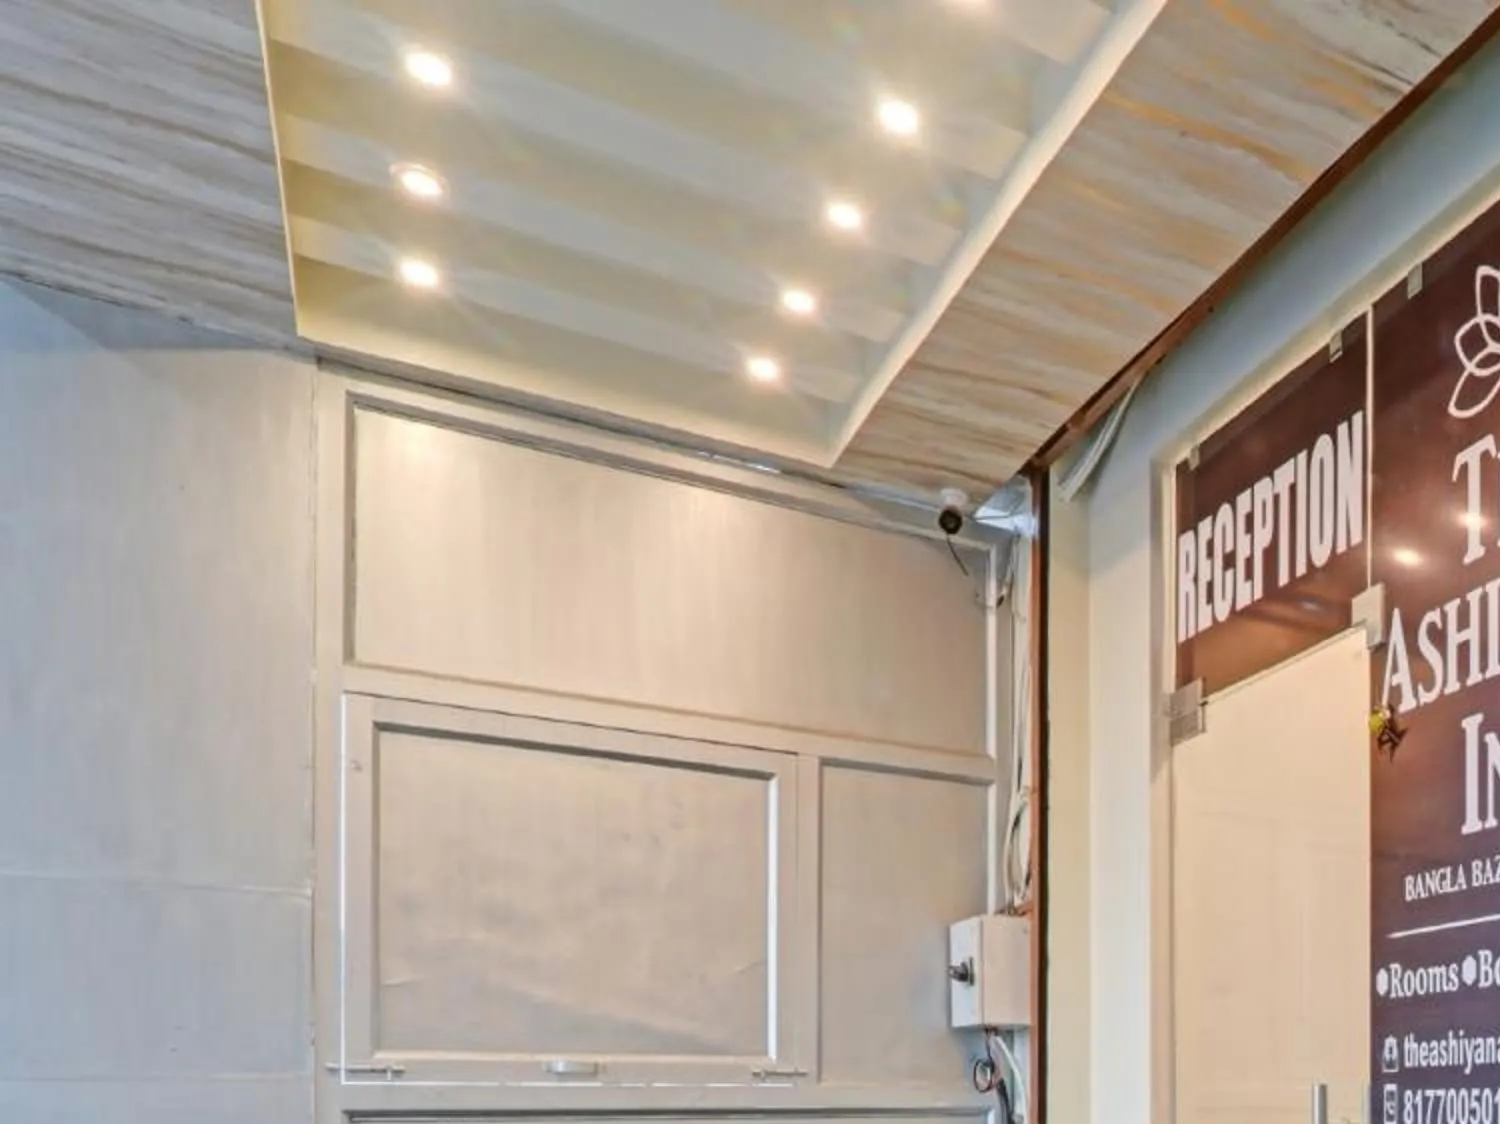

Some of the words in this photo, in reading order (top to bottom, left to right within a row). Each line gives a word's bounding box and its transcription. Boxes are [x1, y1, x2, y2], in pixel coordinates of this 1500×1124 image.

[1177, 410, 1364, 644] RECEPTION
[1404, 864, 1467, 902] BANGLA
[1389, 961, 1459, 998] Rooms
